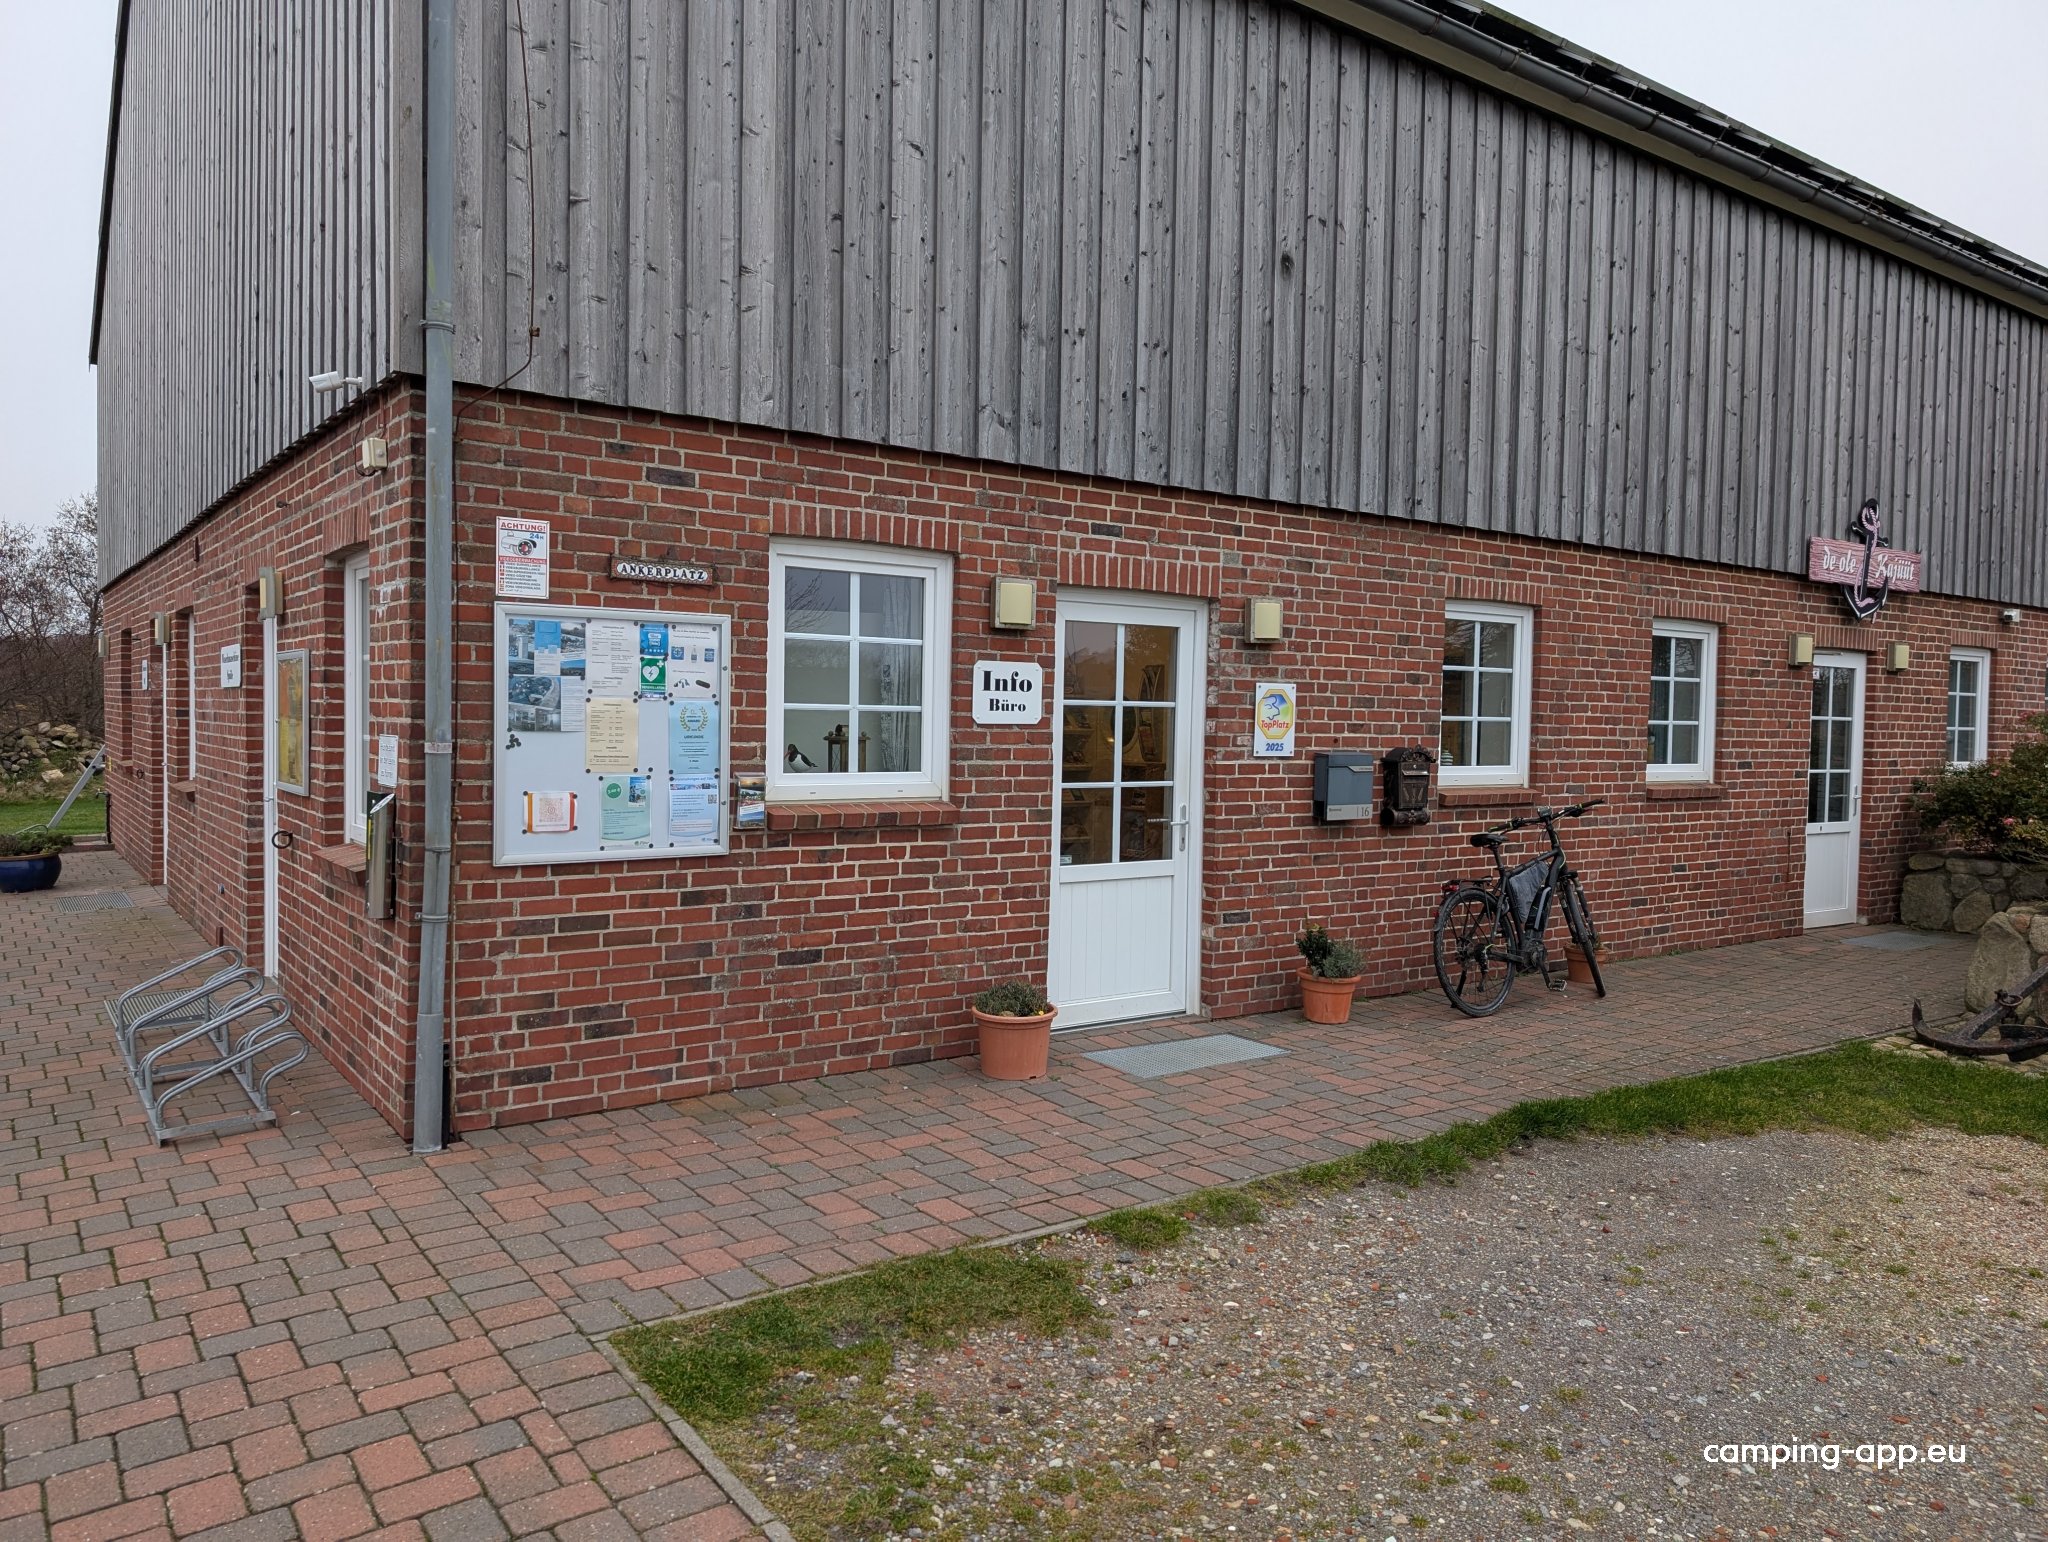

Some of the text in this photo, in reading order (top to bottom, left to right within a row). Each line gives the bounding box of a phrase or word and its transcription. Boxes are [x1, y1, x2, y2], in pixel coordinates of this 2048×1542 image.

[500, 522, 546, 532] ACHTUNG!
[1822, 544, 1836, 571] de
[1839, 549, 1857, 574] ole
[620, 564, 705, 580] ANKERPLATZ
[981, 669, 1033, 693] Info
[988, 698, 1027, 712] Büro
[1261, 720, 1290, 731] TopPlatz
[1265, 743, 1284, 752] 2025
[1360, 806, 1370, 817] 16
